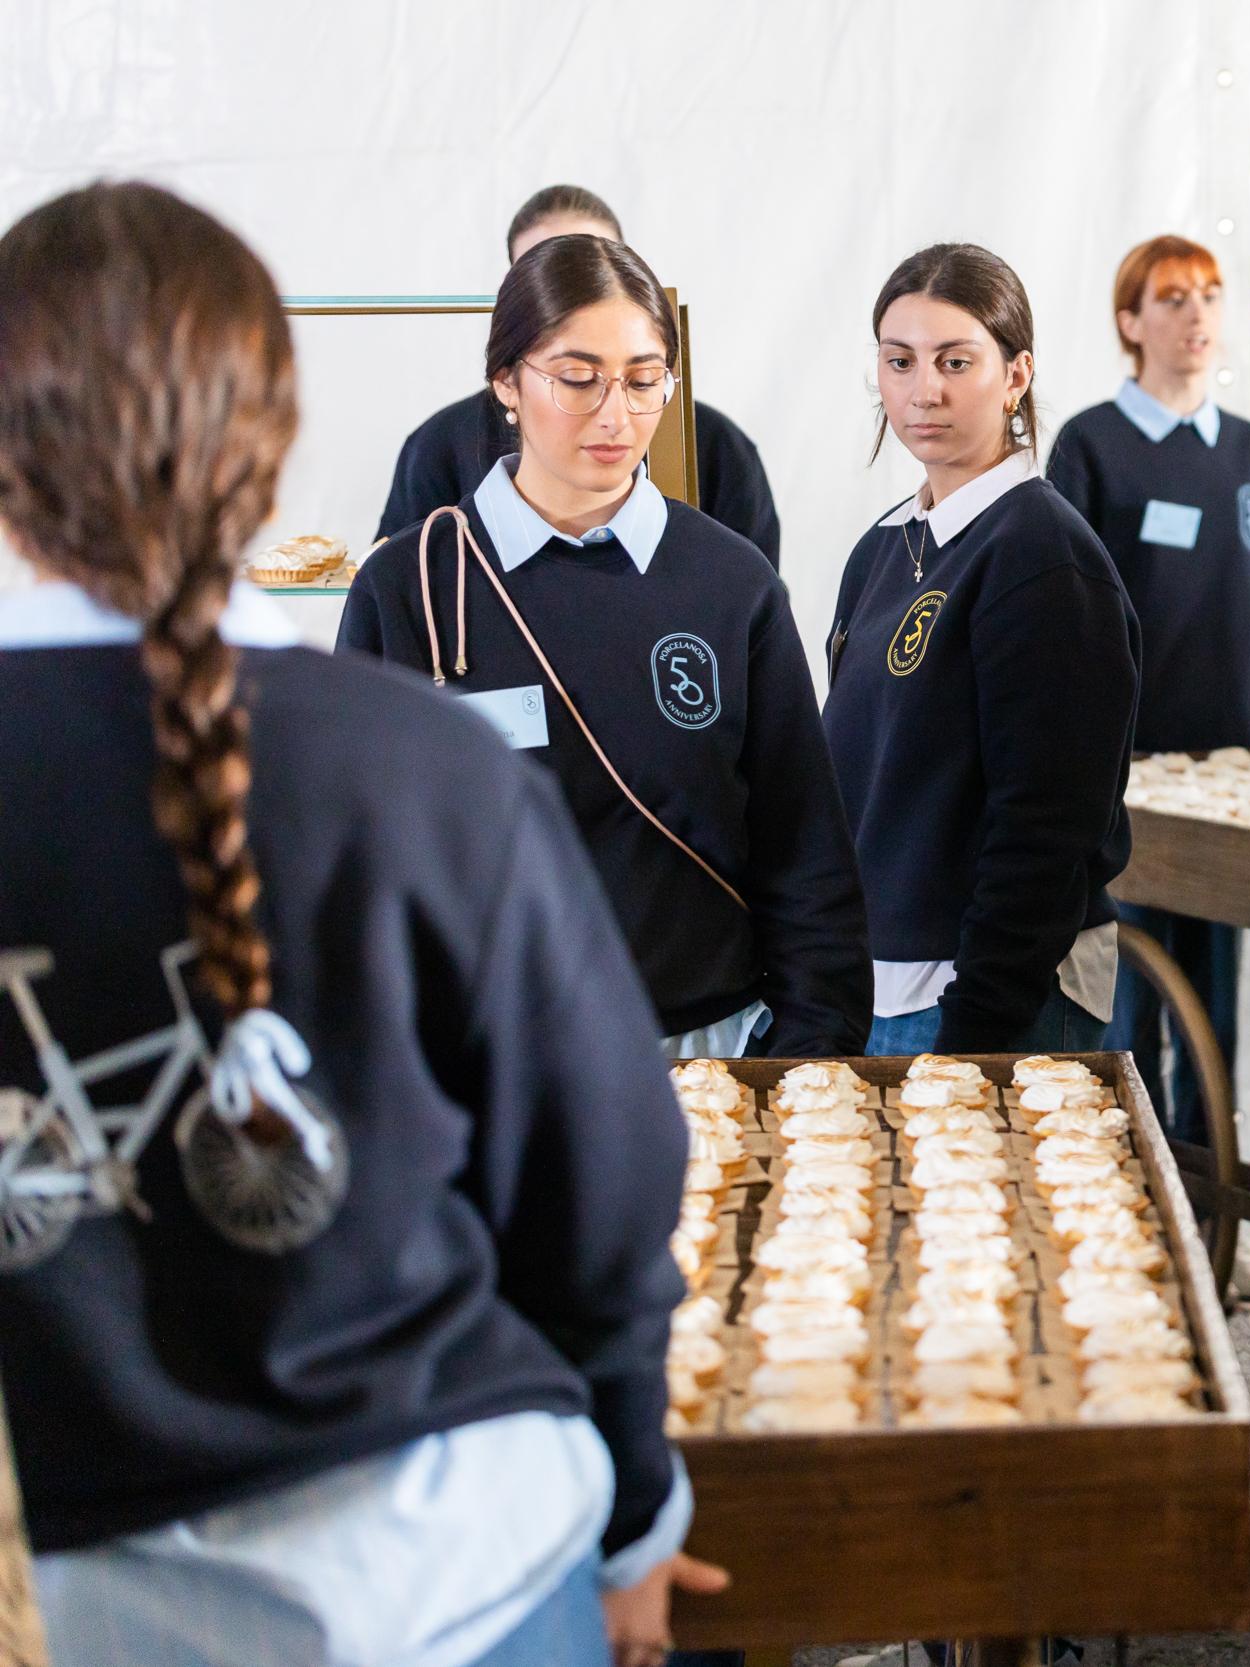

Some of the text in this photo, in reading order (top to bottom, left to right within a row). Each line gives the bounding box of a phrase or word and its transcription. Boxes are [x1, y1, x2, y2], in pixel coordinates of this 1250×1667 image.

[659, 641, 707, 665] PORCELANOSA
[670, 656, 704, 706] 50
[665, 699, 713, 721] ANNIVERSARY
